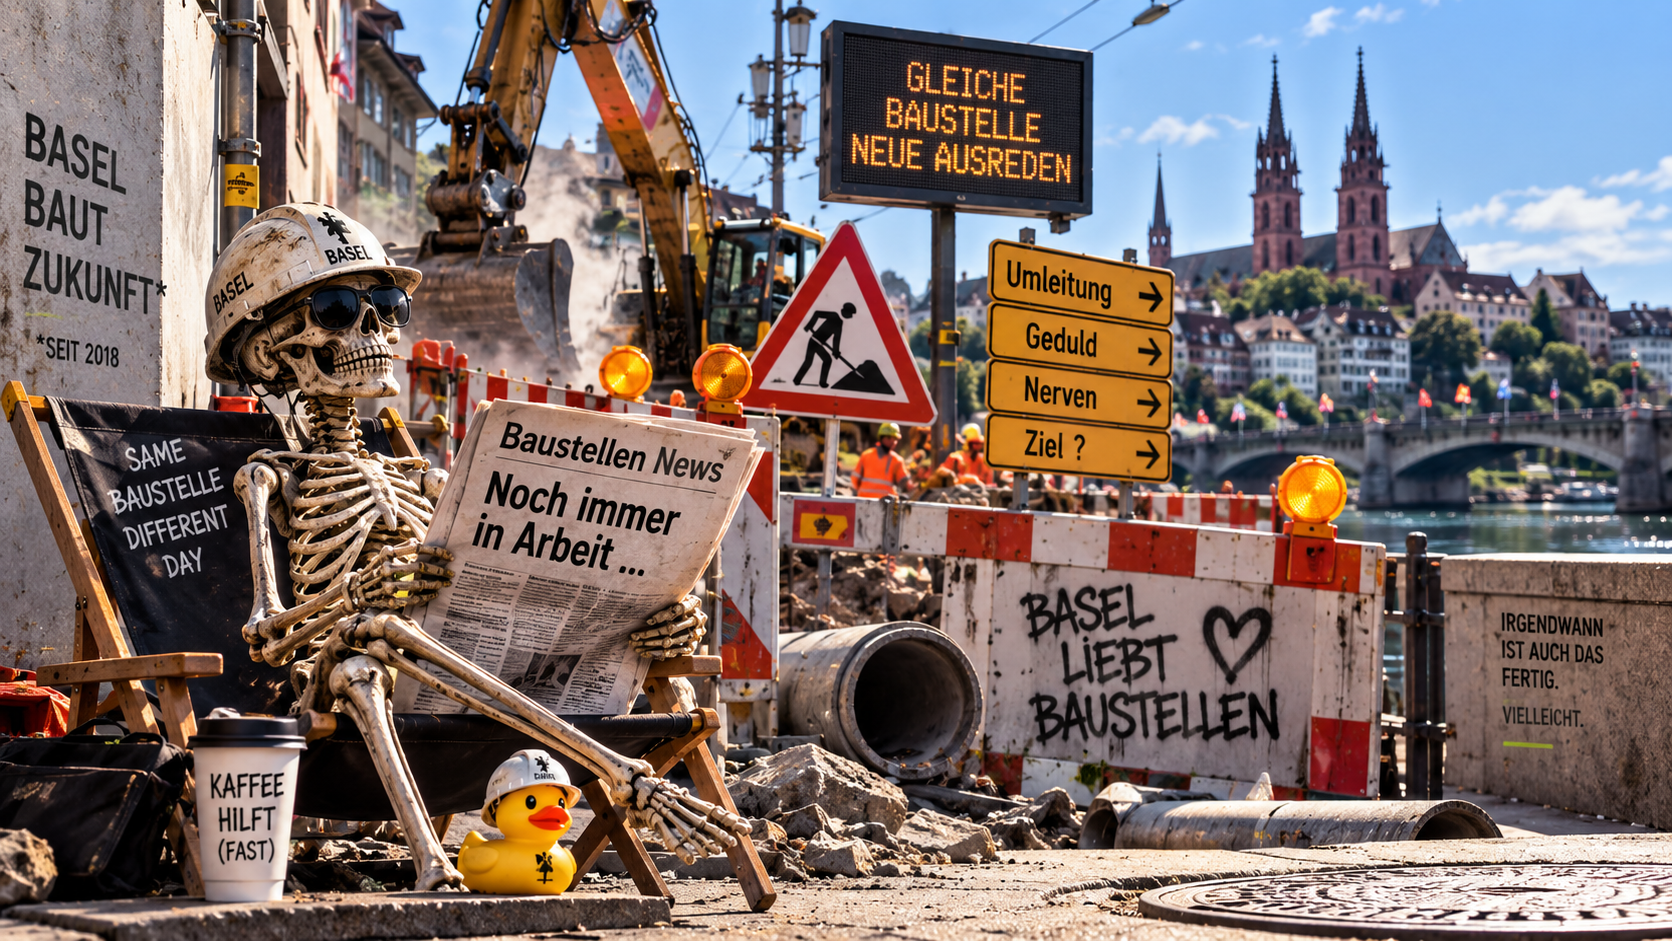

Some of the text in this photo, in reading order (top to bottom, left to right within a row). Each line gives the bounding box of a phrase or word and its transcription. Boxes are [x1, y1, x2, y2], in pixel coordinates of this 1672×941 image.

[907, 61, 1025, 104] GLEICHE
[886, 97, 1041, 143] BAUSTELLE
[25, 112, 126, 195] BASEL
[851, 133, 1071, 183] NEUE AUSREDEN
[25, 179, 108, 246] BAUT
[325, 245, 373, 265] BASEL
[213, 271, 254, 315] BASEL
[1007, 260, 1112, 309] Umleitung
[84, 343, 119, 367] 2018
[1026, 322, 1097, 358] Geduld
[1024, 375, 1097, 409] Nerven
[125, 438, 186, 472] SAME
[499, 421, 724, 483] Baustellen News
[1024, 429, 1086, 461] Ziel ?
[107, 467, 224, 515] BAUSTELLE
[484, 471, 681, 536] Noch immer
[122, 504, 228, 550] DIFFERENT
[472, 513, 504, 551] in
[511, 521, 614, 571] Arbeit
[161, 547, 202, 578] DAY
[1020, 583, 1155, 643] BASEL
[1501, 612, 1604, 638] IRGENDWANN
[1501, 640, 1604, 664] IST AUCH DAS
[1502, 667, 1559, 690] FERTIG.
[1028, 688, 1280, 746] BAUSTELLEN
[1502, 705, 1585, 728] VIELLEICHT.
[210, 772, 285, 799] KAFFEE
[218, 837, 275, 865] (FAST)
